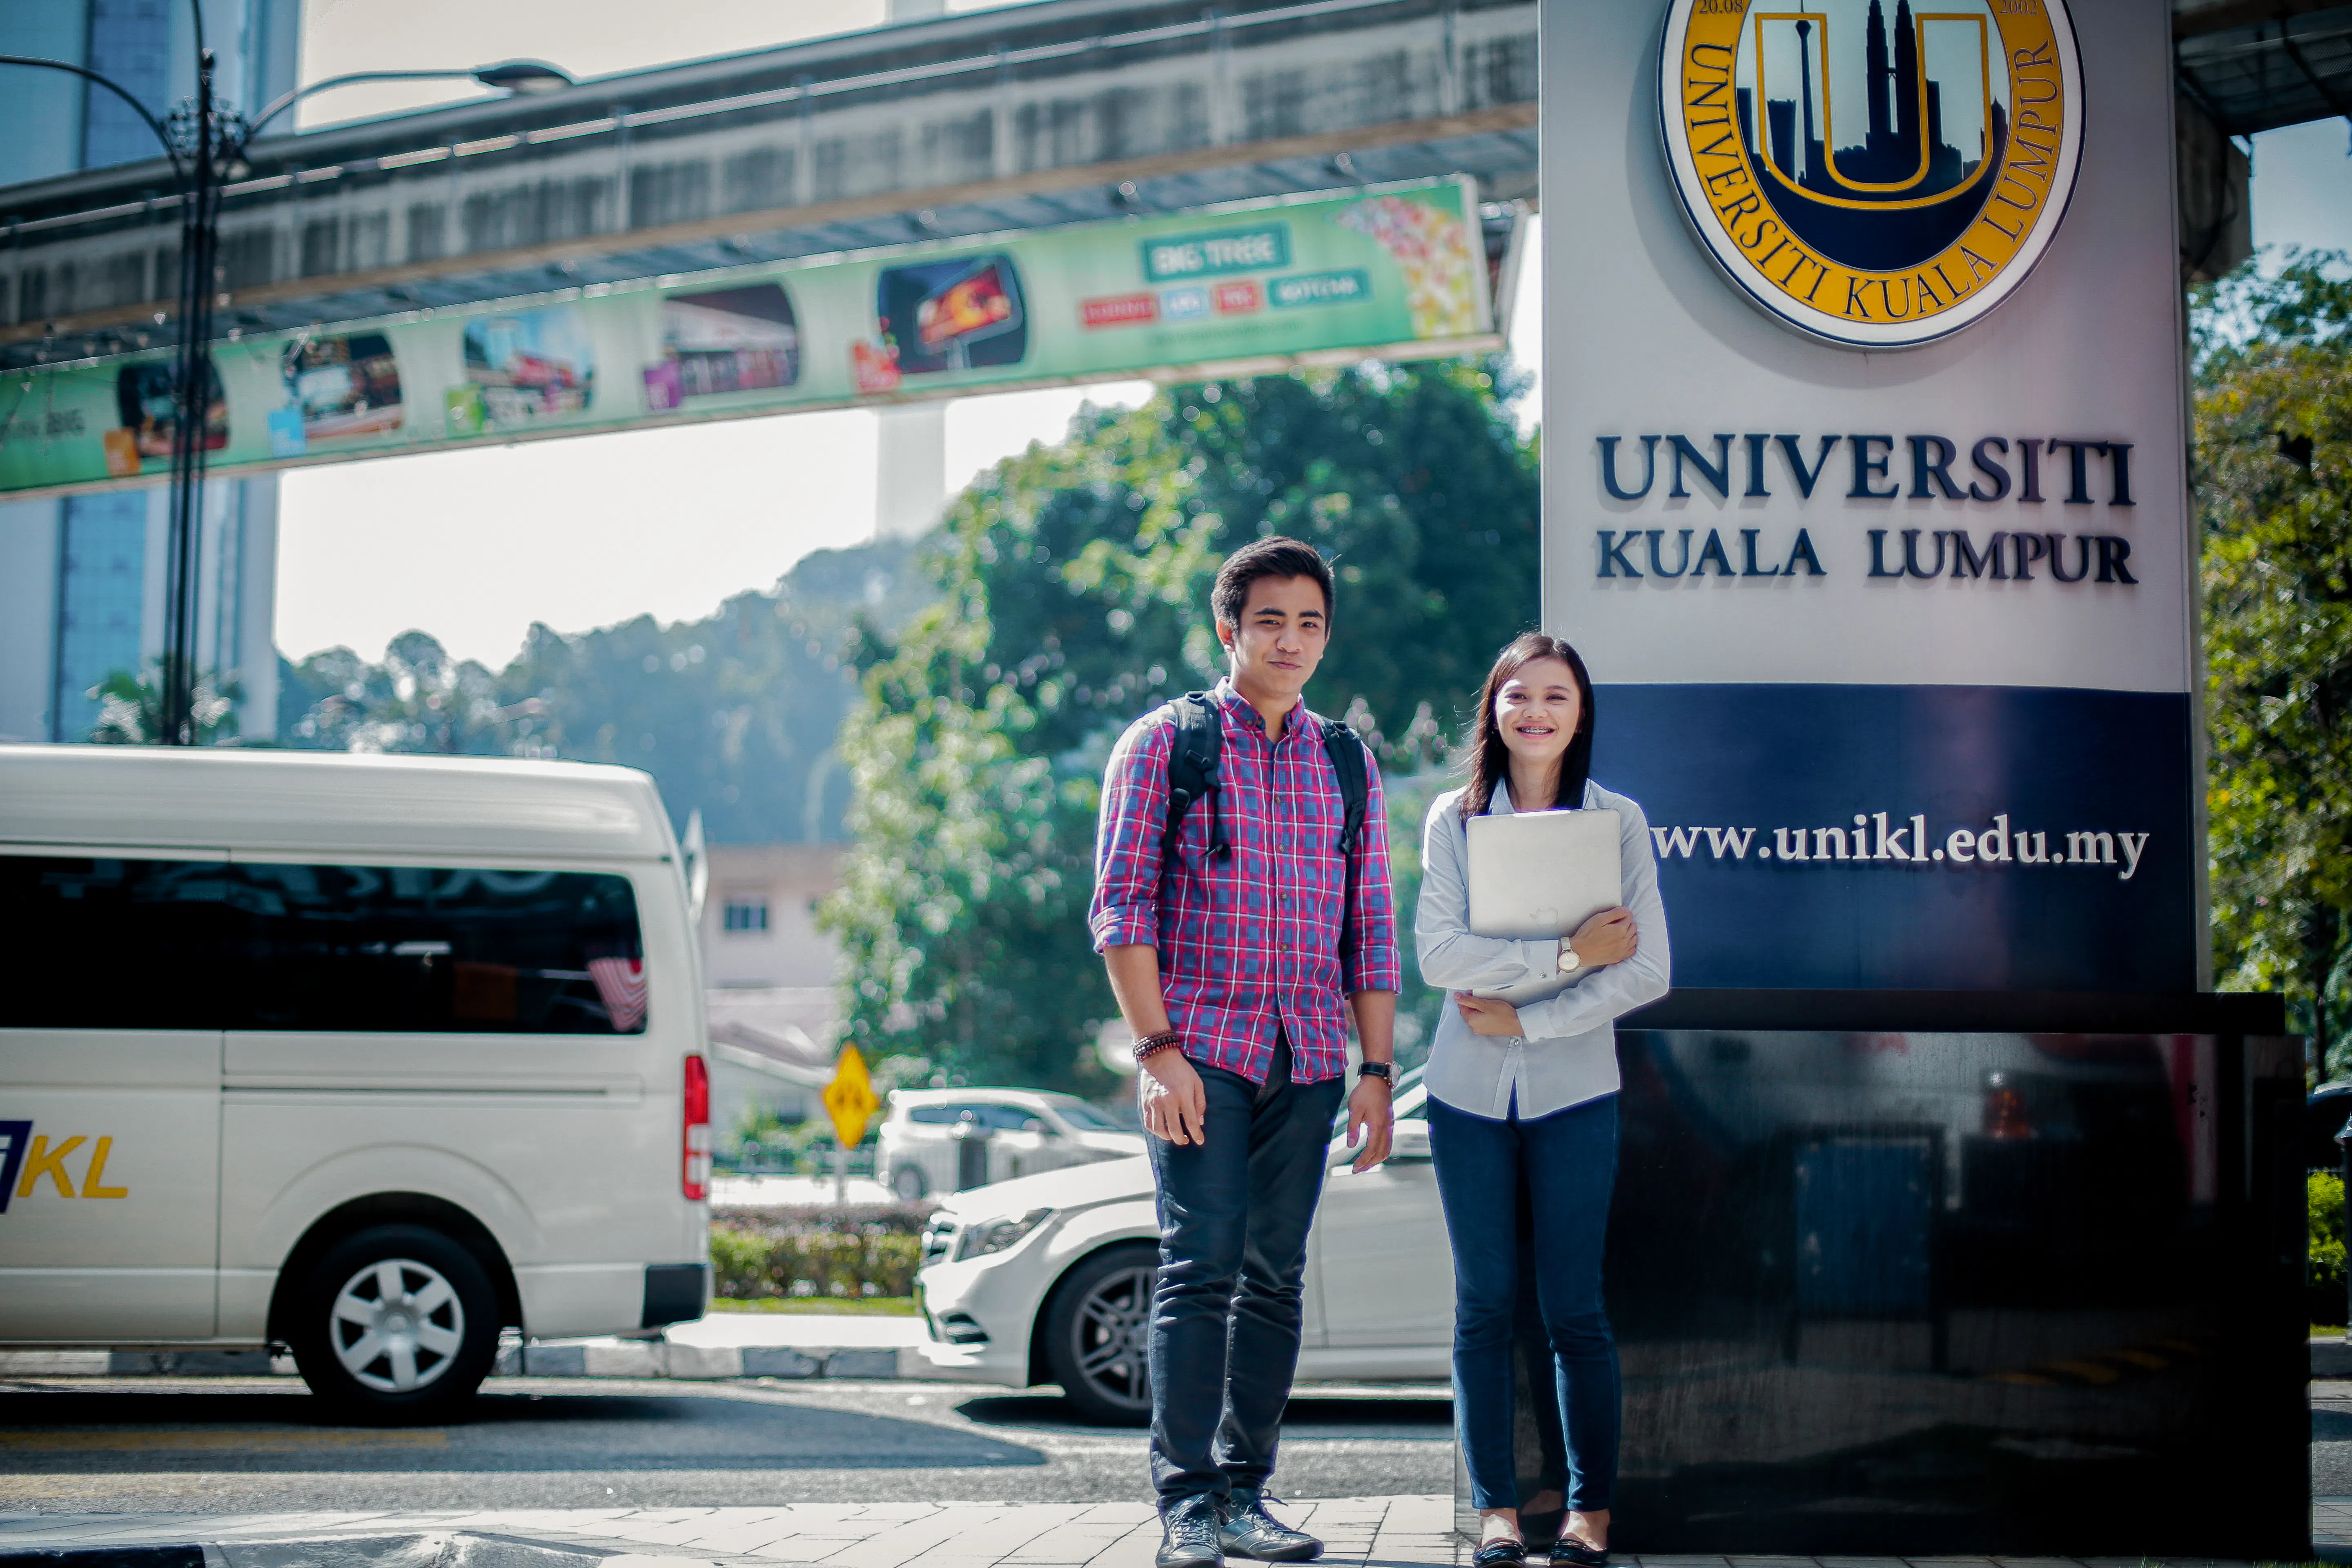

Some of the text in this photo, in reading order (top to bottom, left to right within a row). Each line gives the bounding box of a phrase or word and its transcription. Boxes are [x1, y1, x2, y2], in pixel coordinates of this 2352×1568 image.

[1699, 0, 1744, 13] 20.08
[1999, 0, 2038, 15] 2002
[1688, 38, 2059, 319] UNIVERSITI KUALA LUMPUR
[1597, 434, 2136, 506] UNIVERSITI
[1597, 528, 2139, 584] KUALA LUMPUR
[1650, 811, 2150, 880] ww.unikl.edu.my
